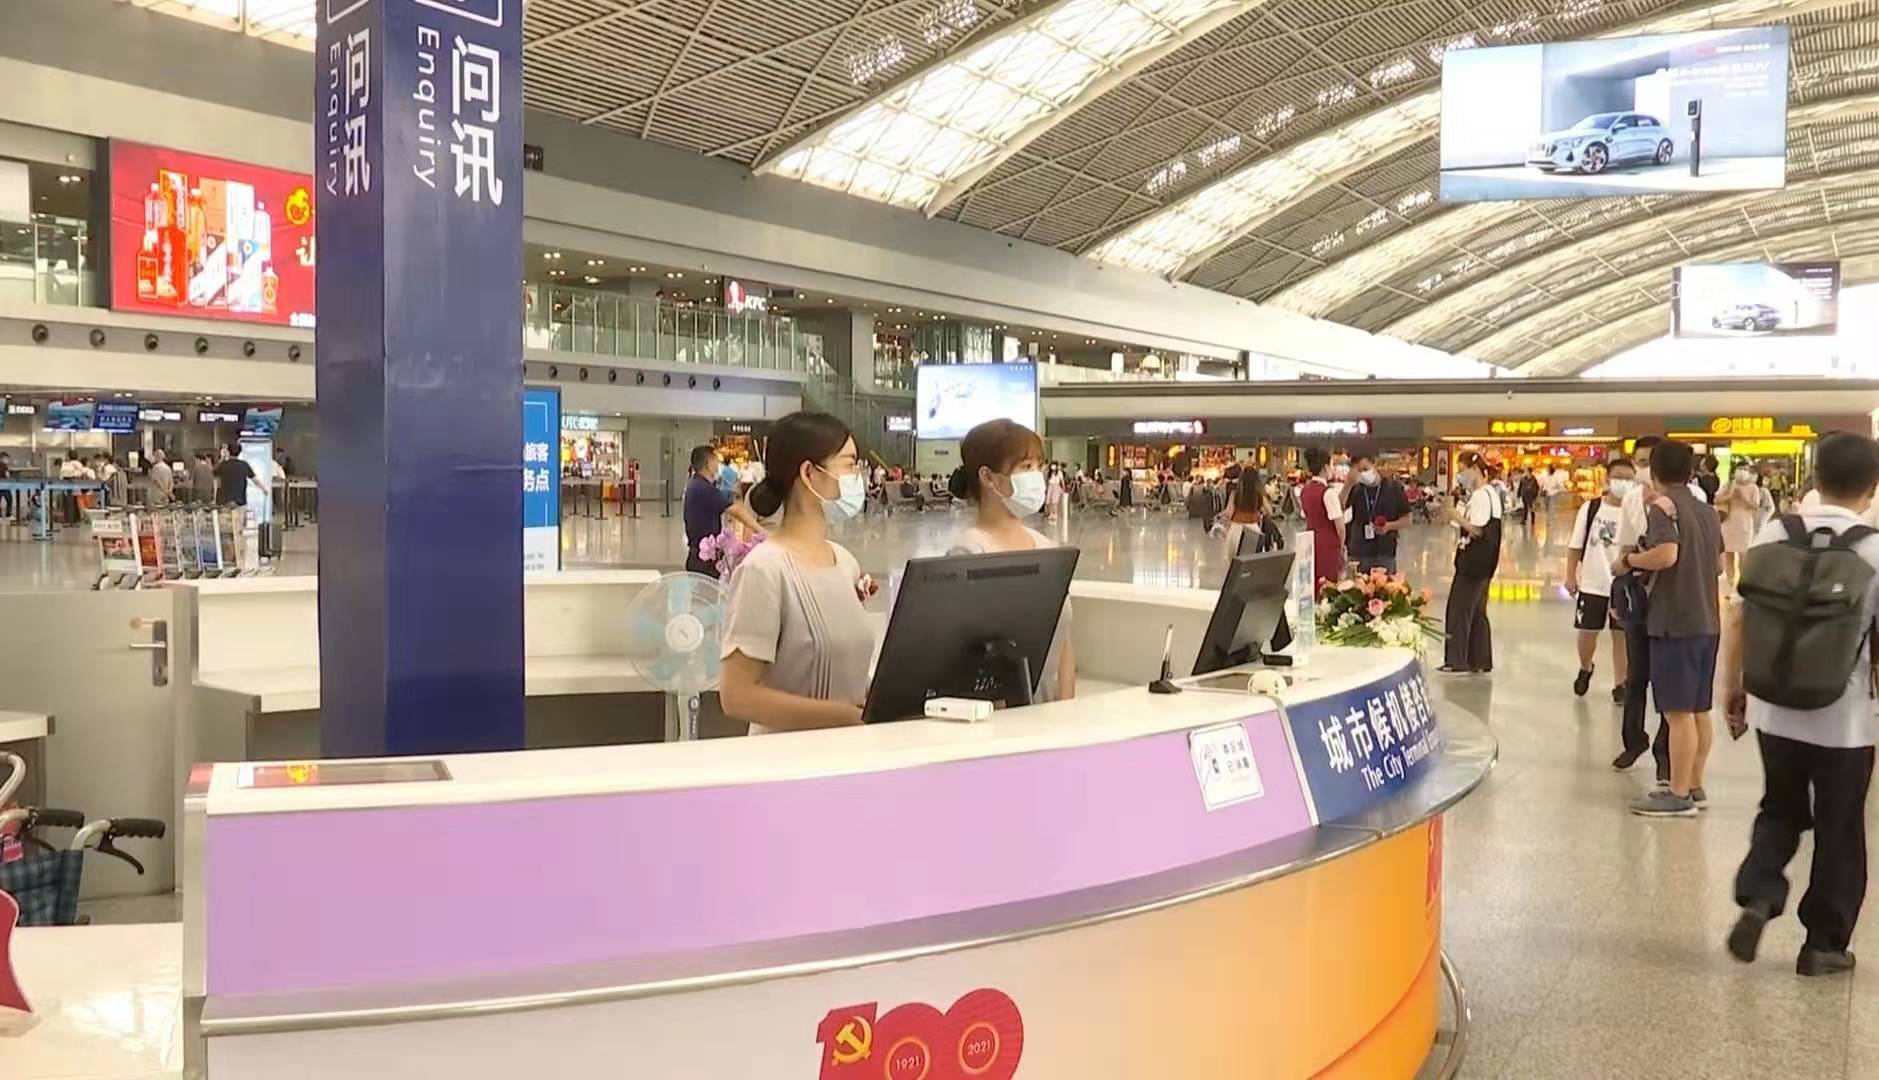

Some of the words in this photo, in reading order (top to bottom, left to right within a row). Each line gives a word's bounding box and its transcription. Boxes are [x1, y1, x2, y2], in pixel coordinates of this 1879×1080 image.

[326, 41, 342, 197] Enquiry
[343, 27, 371, 197] 问讯
[413, 25, 442, 189] Enquiry
[450, 34, 504, 207] 问讯
[744, 294, 768, 312] KFC
[1360, 764, 1386, 792] The
[1383, 752, 1406, 780] City
[895, 1055, 920, 1072] 1921
[967, 1040, 992, 1056] 2021
